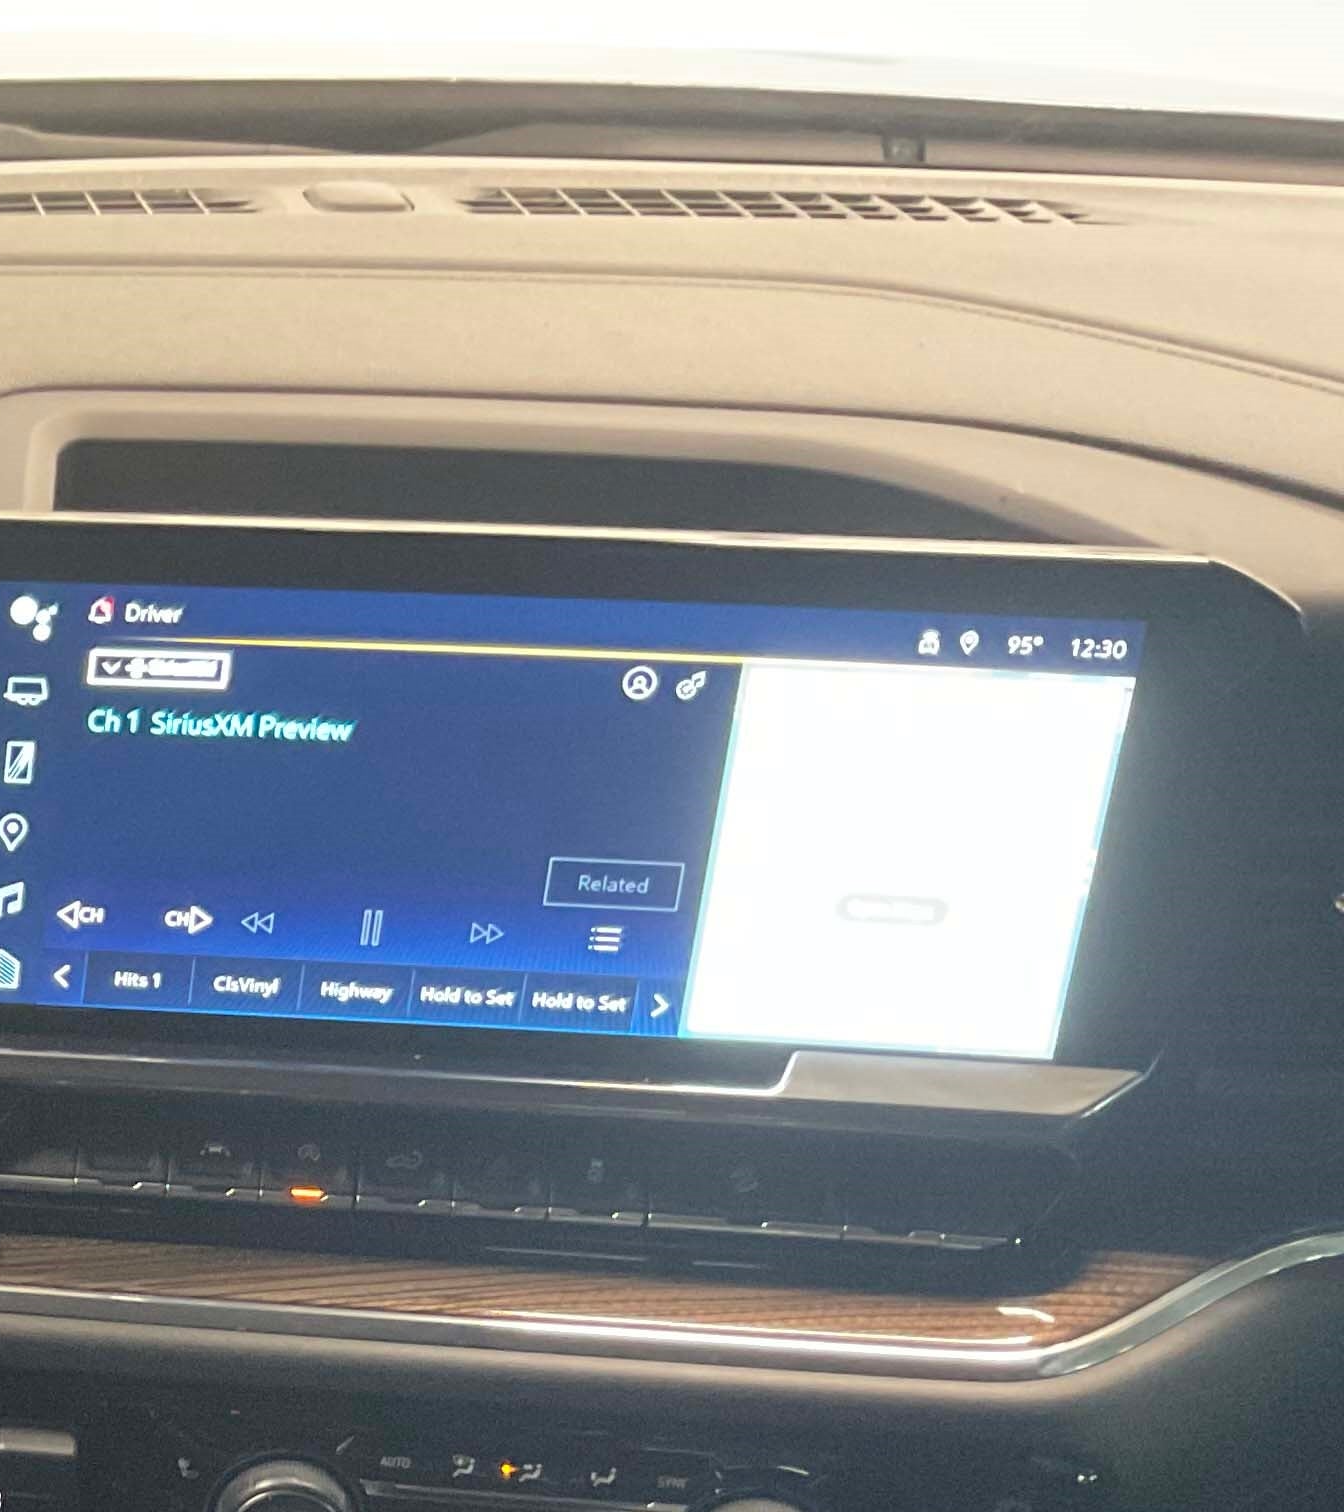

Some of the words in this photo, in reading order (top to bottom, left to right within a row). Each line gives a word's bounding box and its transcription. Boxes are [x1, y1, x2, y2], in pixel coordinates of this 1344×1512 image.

[125, 603, 184, 624] Driver
[1071, 638, 1128, 660] 12:30
[87, 707, 121, 734] Ch
[126, 708, 141, 734] 1
[150, 709, 255, 738] SiriusXM
[258, 714, 358, 742] Preview
[578, 874, 650, 895] Related
[79, 907, 105, 923] CH
[164, 910, 190, 928] CH
[114, 971, 148, 988] Hits
[152, 972, 162, 989] 1
[320, 980, 394, 1003] Highway
[420, 985, 462, 1005] Hold
[464, 987, 482, 1005] to
[485, 988, 516, 1008] Set
[532, 991, 572, 1011] Hold
[576, 993, 594, 1011] to
[597, 993, 628, 1013] Set
[380, 1456, 411, 1469] AUTO
